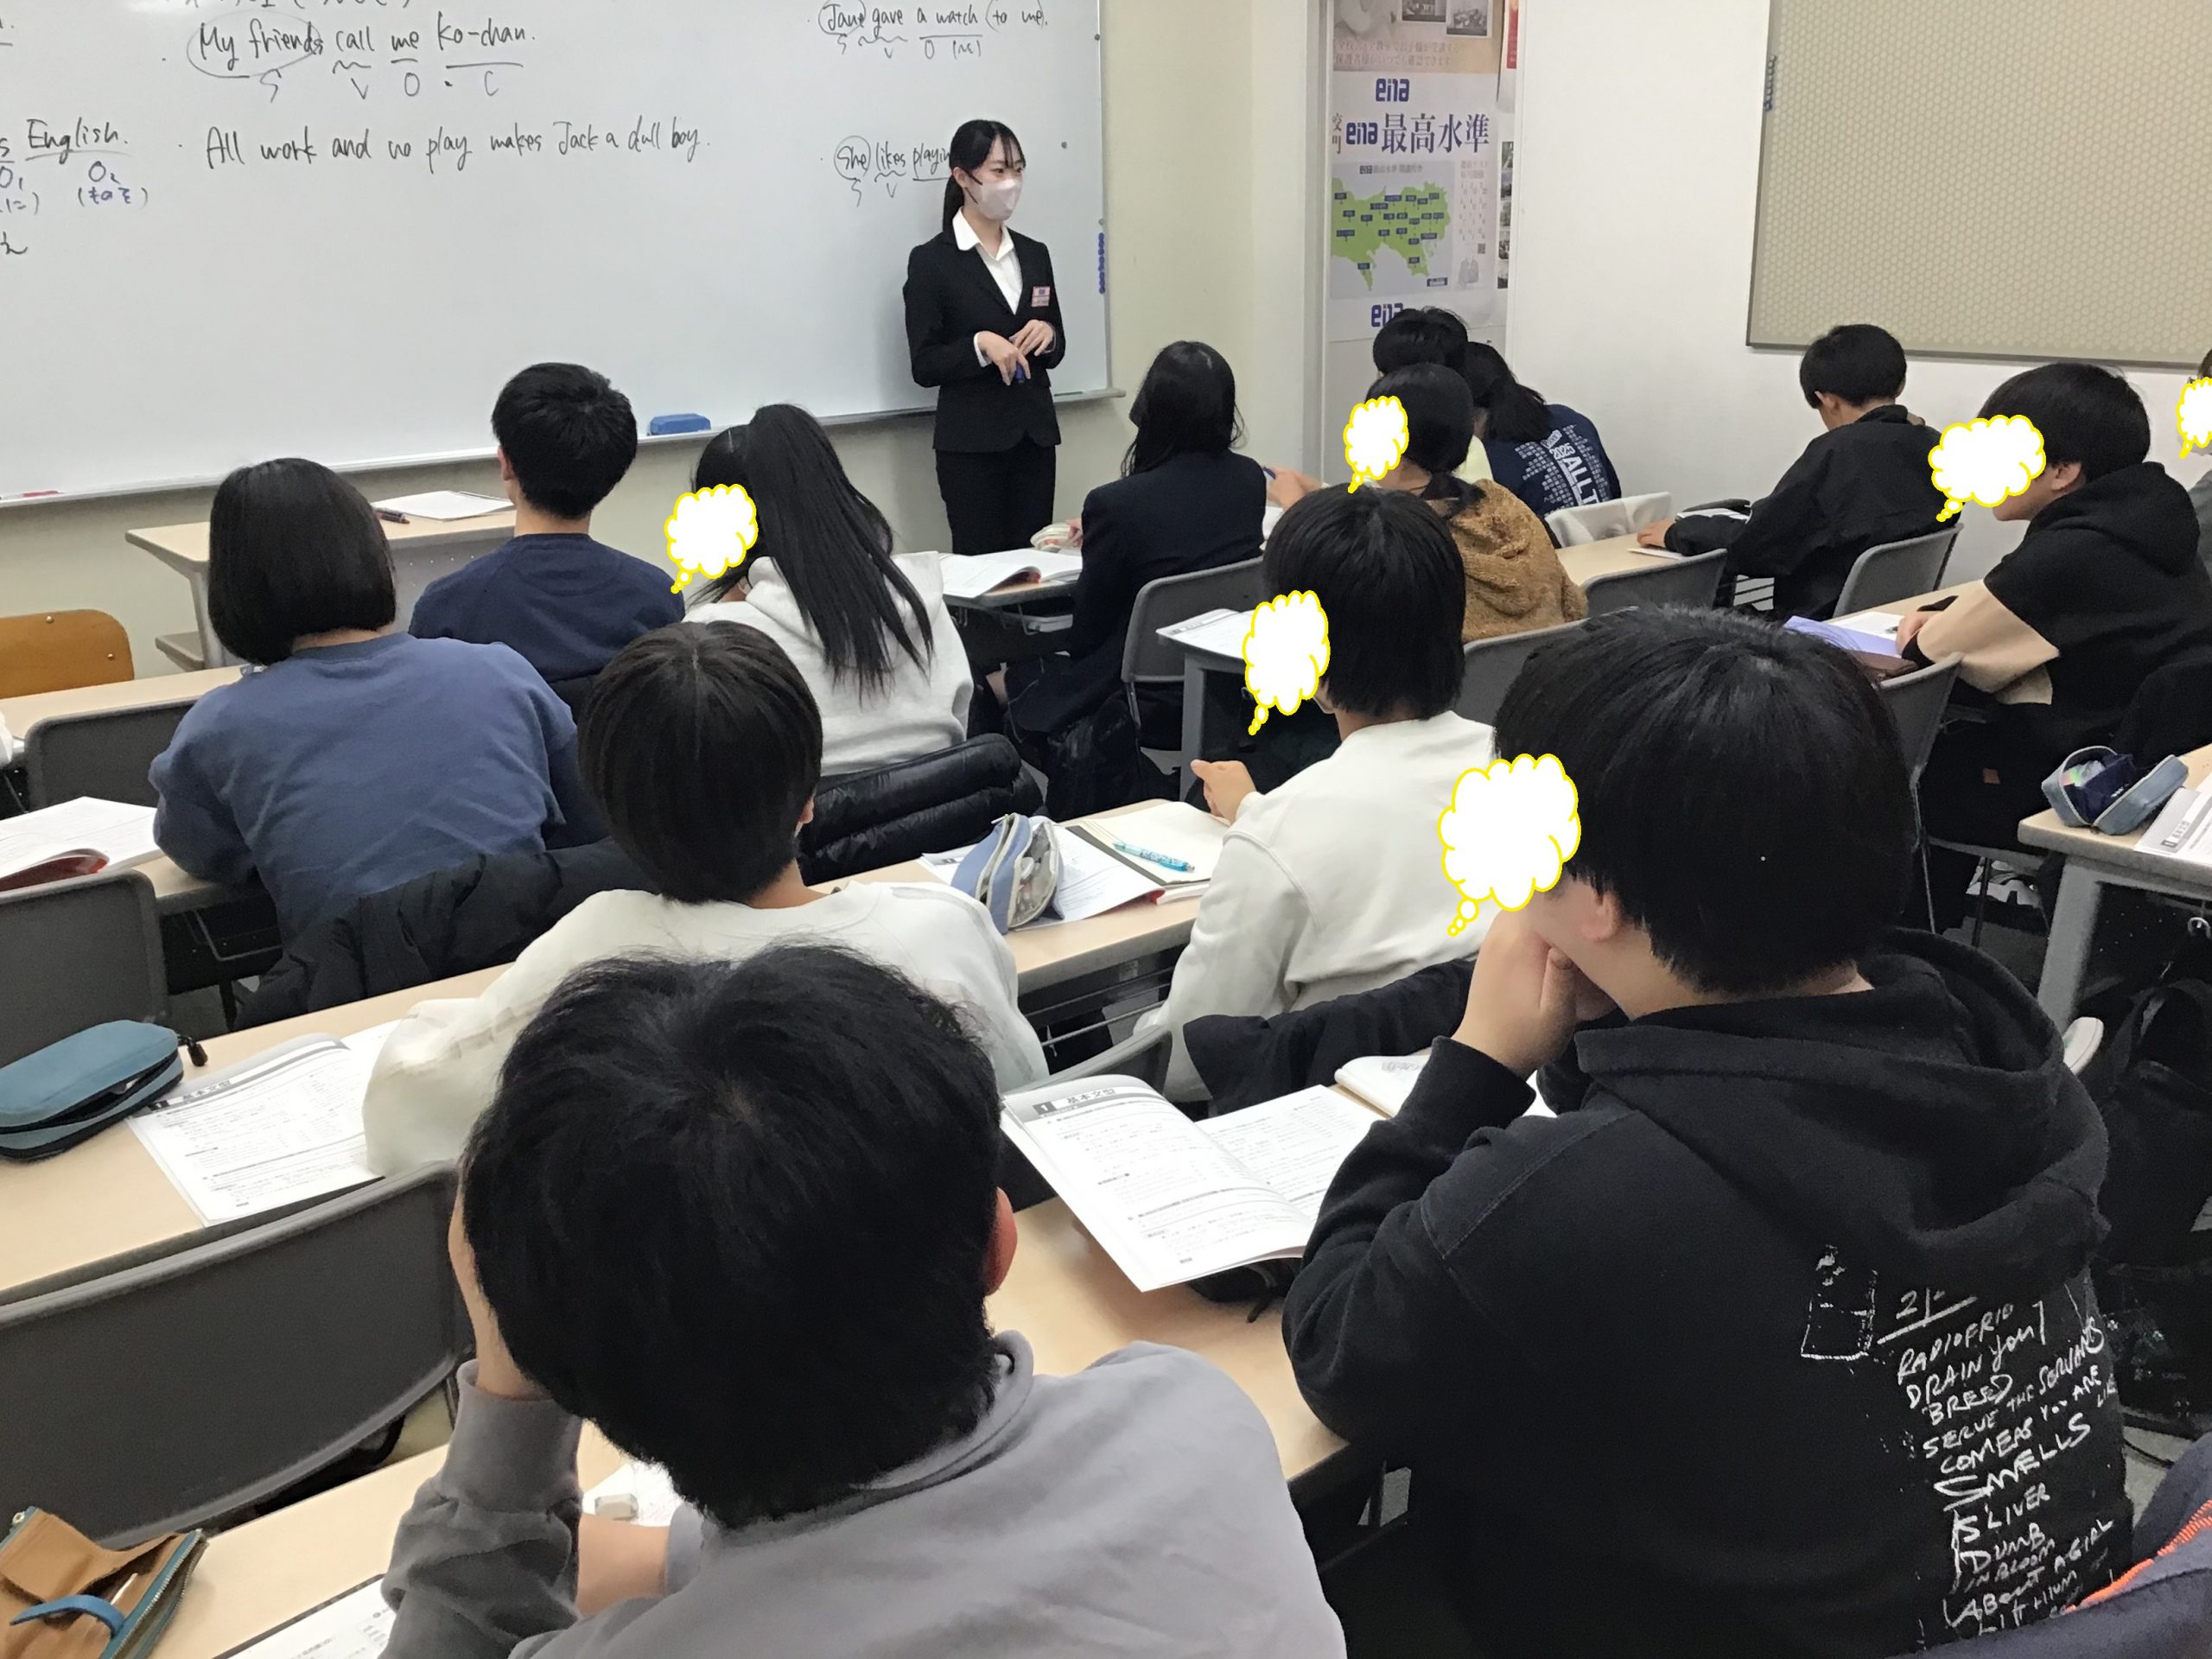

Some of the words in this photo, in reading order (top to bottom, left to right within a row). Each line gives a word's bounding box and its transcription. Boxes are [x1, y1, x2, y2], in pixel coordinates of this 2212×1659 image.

[200, 22, 239, 72] My
[249, 18, 323, 59] friends
[336, 26, 375, 52] call
[392, 31, 419, 52] me
[823, 3, 864, 31] Jane
[872, 8, 904, 39] gave
[917, 8, 927, 23] a
[936, 4, 978, 25] watch
[27, 116, 129, 164] English.
[207, 126, 245, 168] All
[261, 126, 317, 165] work
[333, 128, 372, 159] and
[388, 139, 411, 159] no
[426, 126, 474, 174] play
[491, 123, 543, 156] makes
[553, 120, 598, 156] Jack
[606, 133, 619, 149] a
[628, 115, 661, 152] dull
[671, 116, 710, 162] boy.
[836, 145, 868, 171] She
[875, 141, 906, 171] likes
[1382, 113, 1490, 154] 最高水準
[1923, 1408, 1999, 1459] SERVE
[1933, 1412, 2092, 1511] SMELLS
